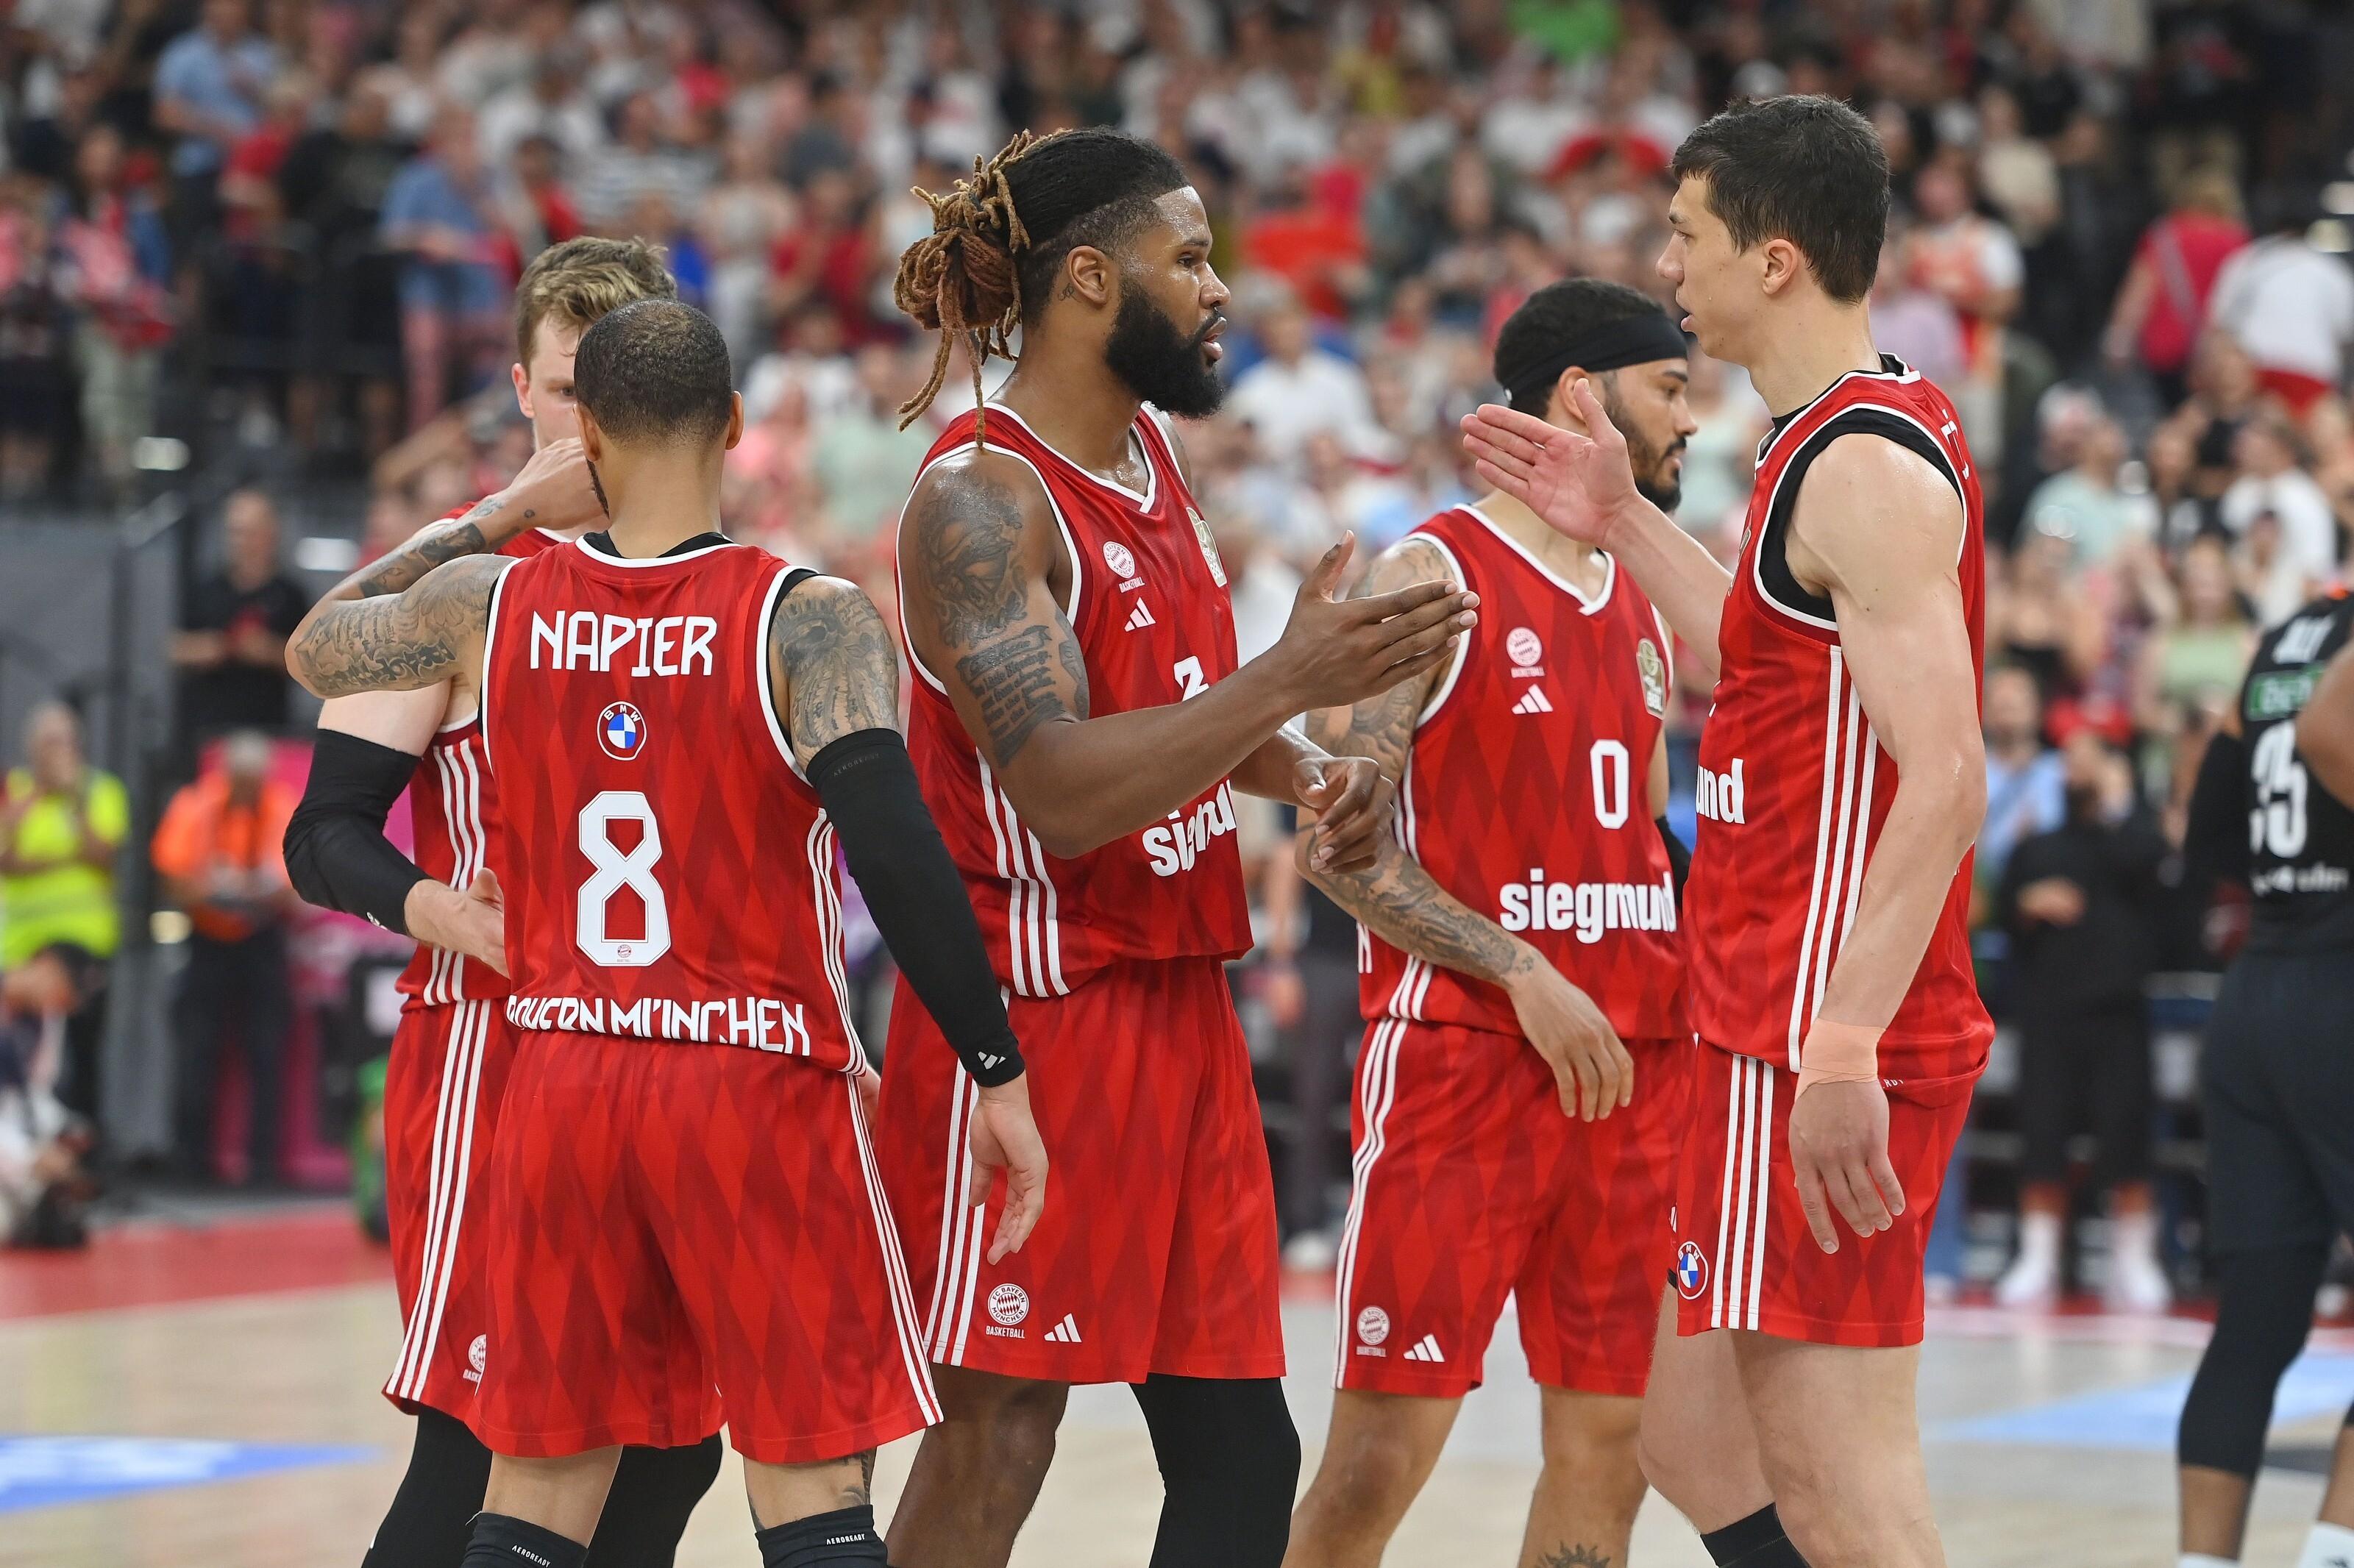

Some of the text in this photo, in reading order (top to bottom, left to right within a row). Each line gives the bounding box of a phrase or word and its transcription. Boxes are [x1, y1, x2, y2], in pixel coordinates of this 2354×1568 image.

[530, 610, 717, 677] NAPIER
[603, 705, 641, 722] BMW
[1590, 739, 1629, 830] 0
[576, 791, 671, 967] 8
[1678, 1244, 1700, 1260] BMW
[992, 1287, 1025, 1302] FC BAYERN
[986, 1325, 1025, 1339] BASKETBALL
[826, 1533, 865, 1545] AEROREADY
[511, 1544, 551, 1568] AEROREADY
